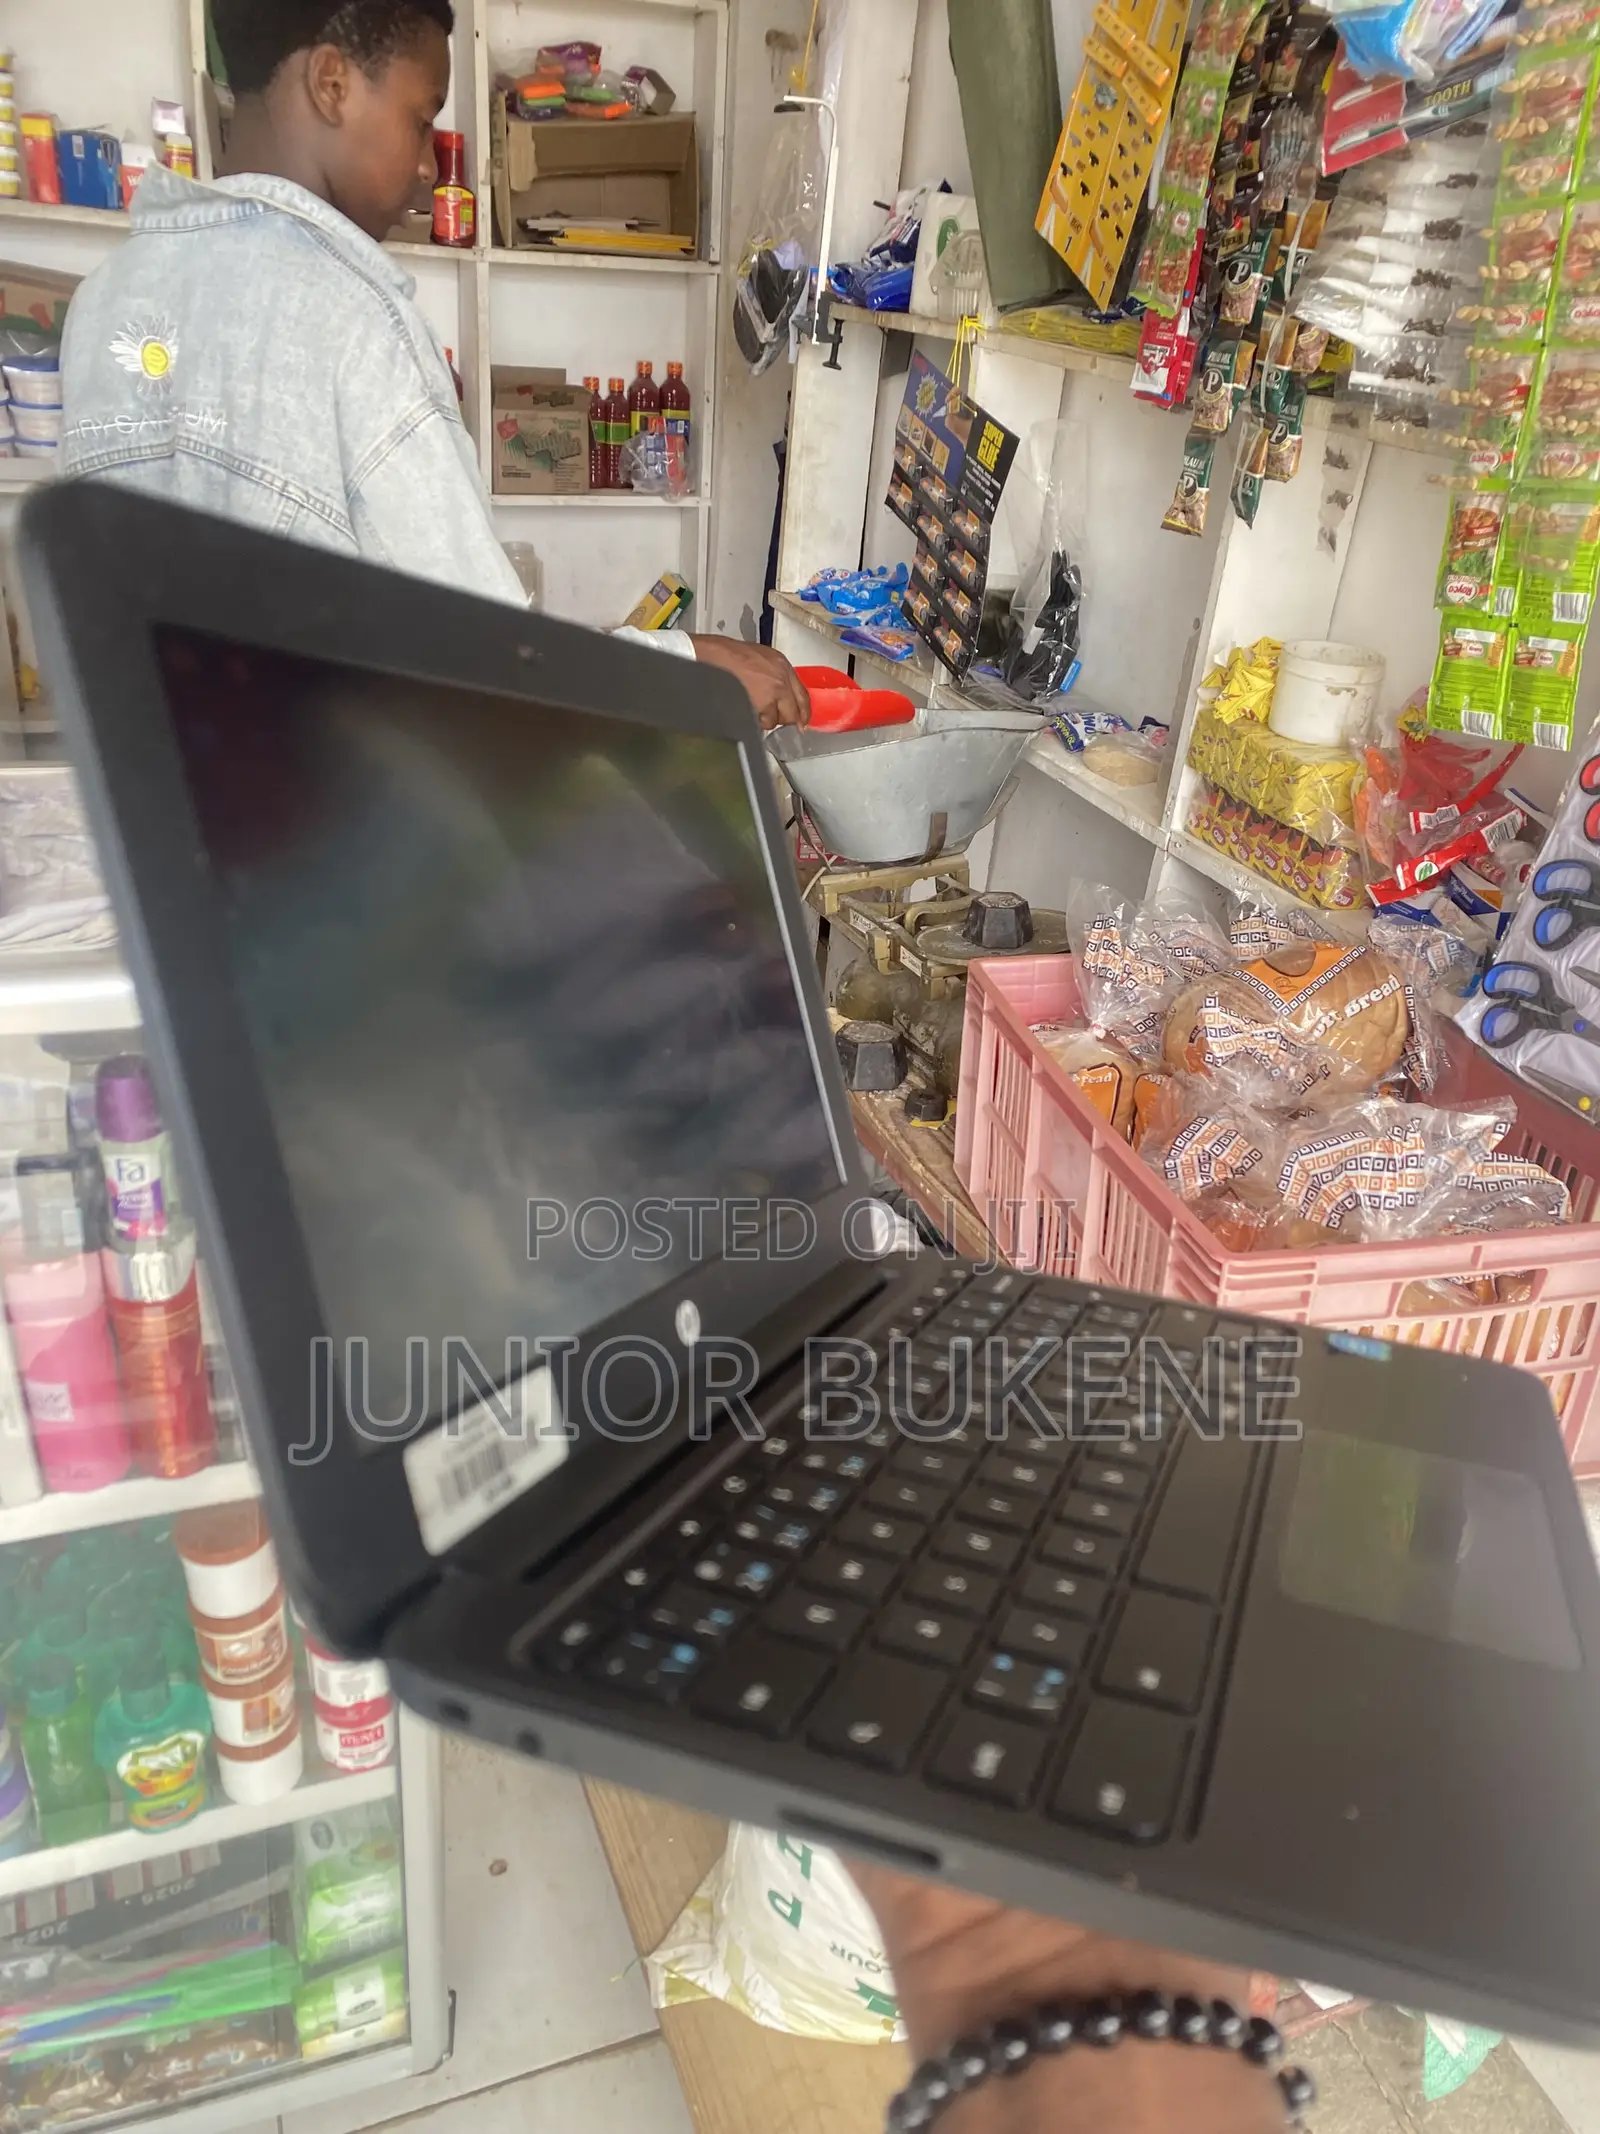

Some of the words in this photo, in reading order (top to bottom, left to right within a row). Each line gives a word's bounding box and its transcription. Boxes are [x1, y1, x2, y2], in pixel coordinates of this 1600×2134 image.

[1424, 79, 1473, 107] TOOTH
[1233, 261, 1249, 284] P
[1206, 371, 1219, 393] P
[983, 420, 1005, 449] SUPER
[1270, 422, 1286, 441] P
[977, 439, 1001, 472] GLUE
[1448, 584, 1473, 596] Royco
[1343, 973, 1403, 1019] Bread
[116, 1158, 145, 1183] Fa
